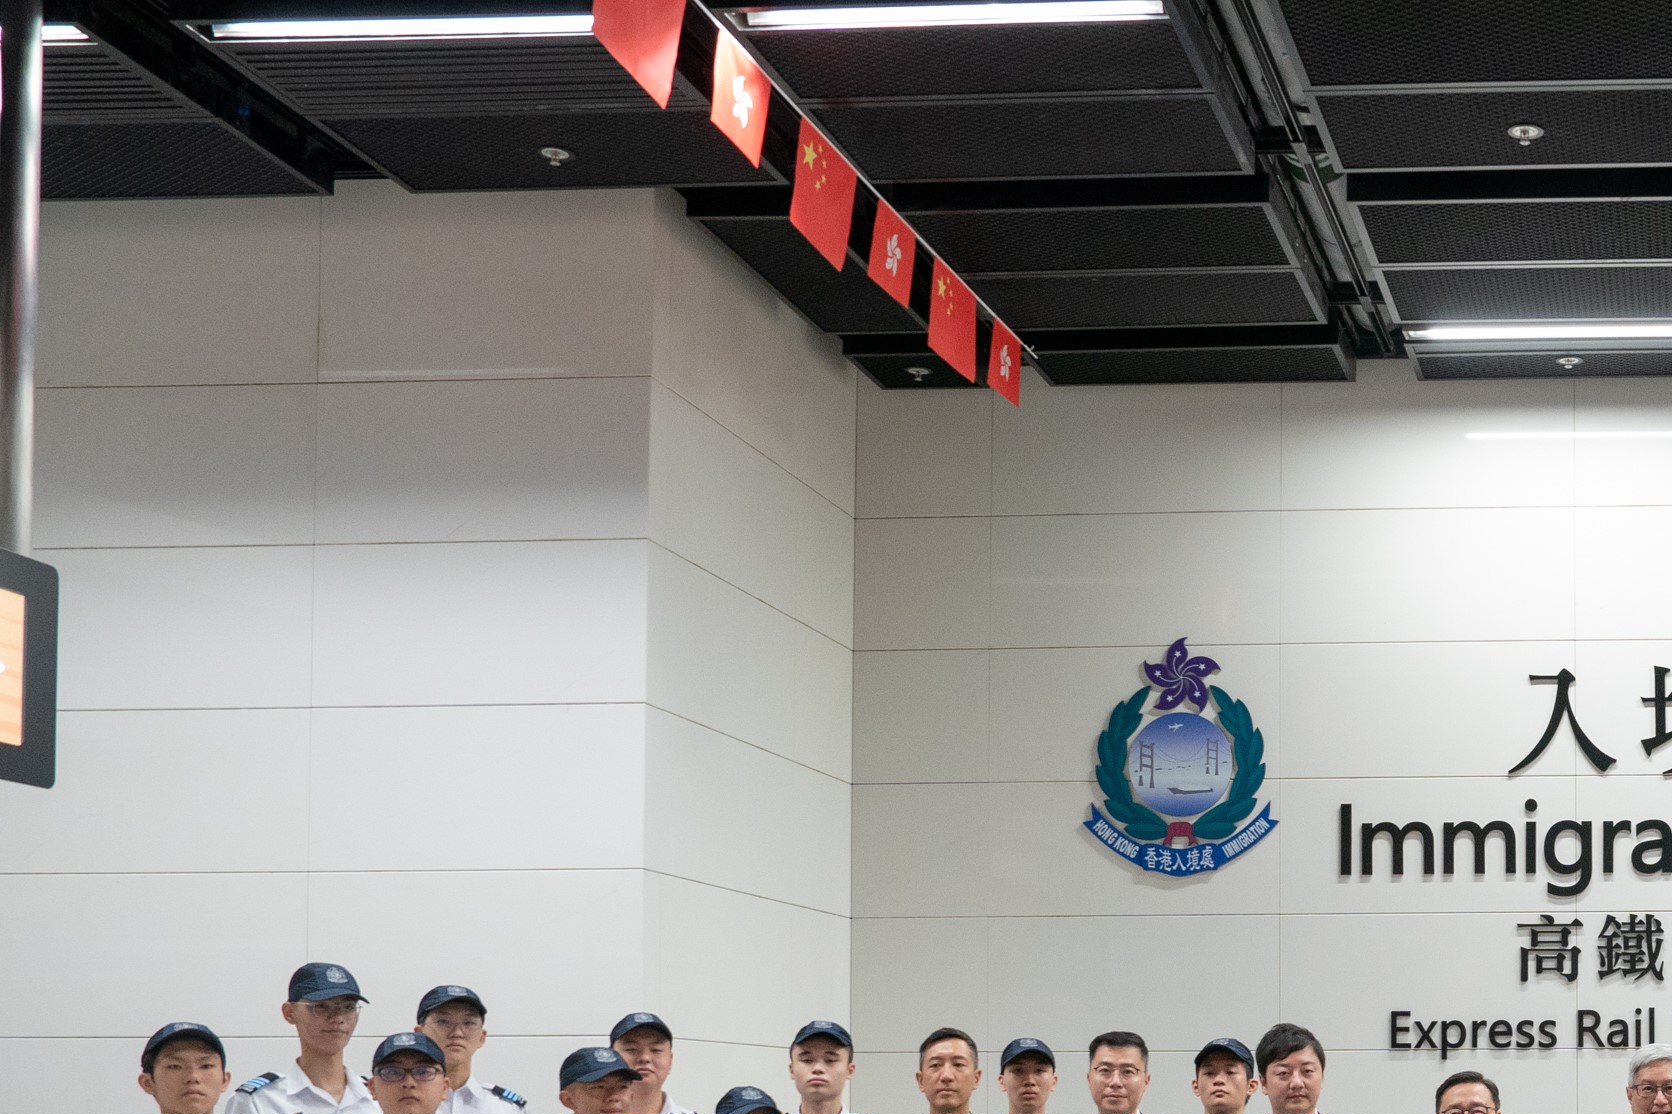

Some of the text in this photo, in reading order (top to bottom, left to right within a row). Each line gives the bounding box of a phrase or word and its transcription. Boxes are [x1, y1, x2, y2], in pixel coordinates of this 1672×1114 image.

[1092, 819, 1140, 859] HONG KONG
[1222, 817, 1271, 859] IMMIGRATION
[1144, 846, 1215, 872] 香港入境處
[1390, 1011, 1557, 1060] Express
[1577, 1007, 1656, 1048] Rail
